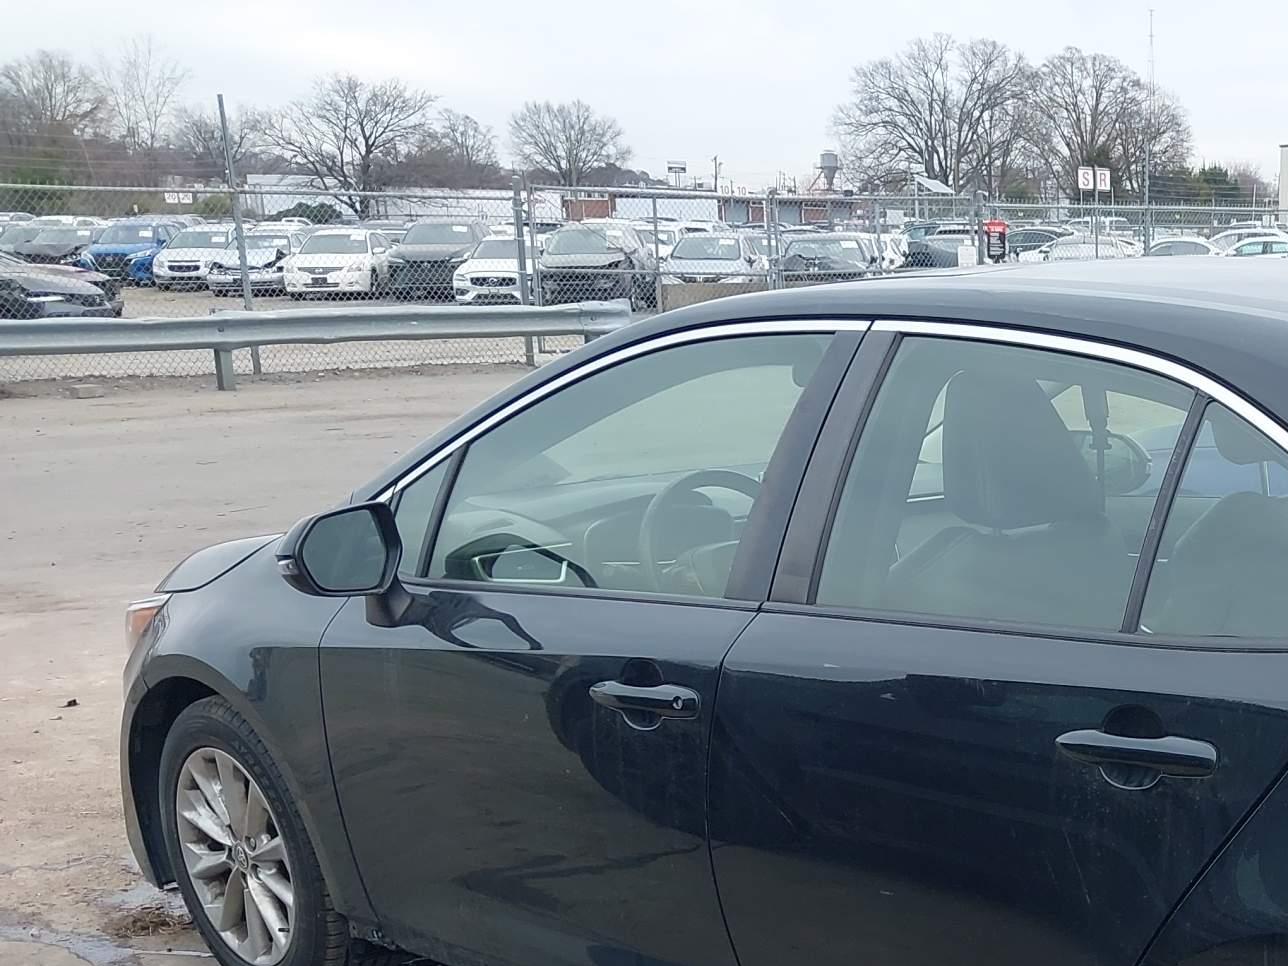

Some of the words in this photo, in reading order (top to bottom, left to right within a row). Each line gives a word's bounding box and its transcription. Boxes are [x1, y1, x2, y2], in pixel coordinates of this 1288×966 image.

[1082, 171, 1090, 187] S
[1099, 172, 1107, 188] R
[720, 185, 730, 195] 10
[736, 186, 747, 196] 10
